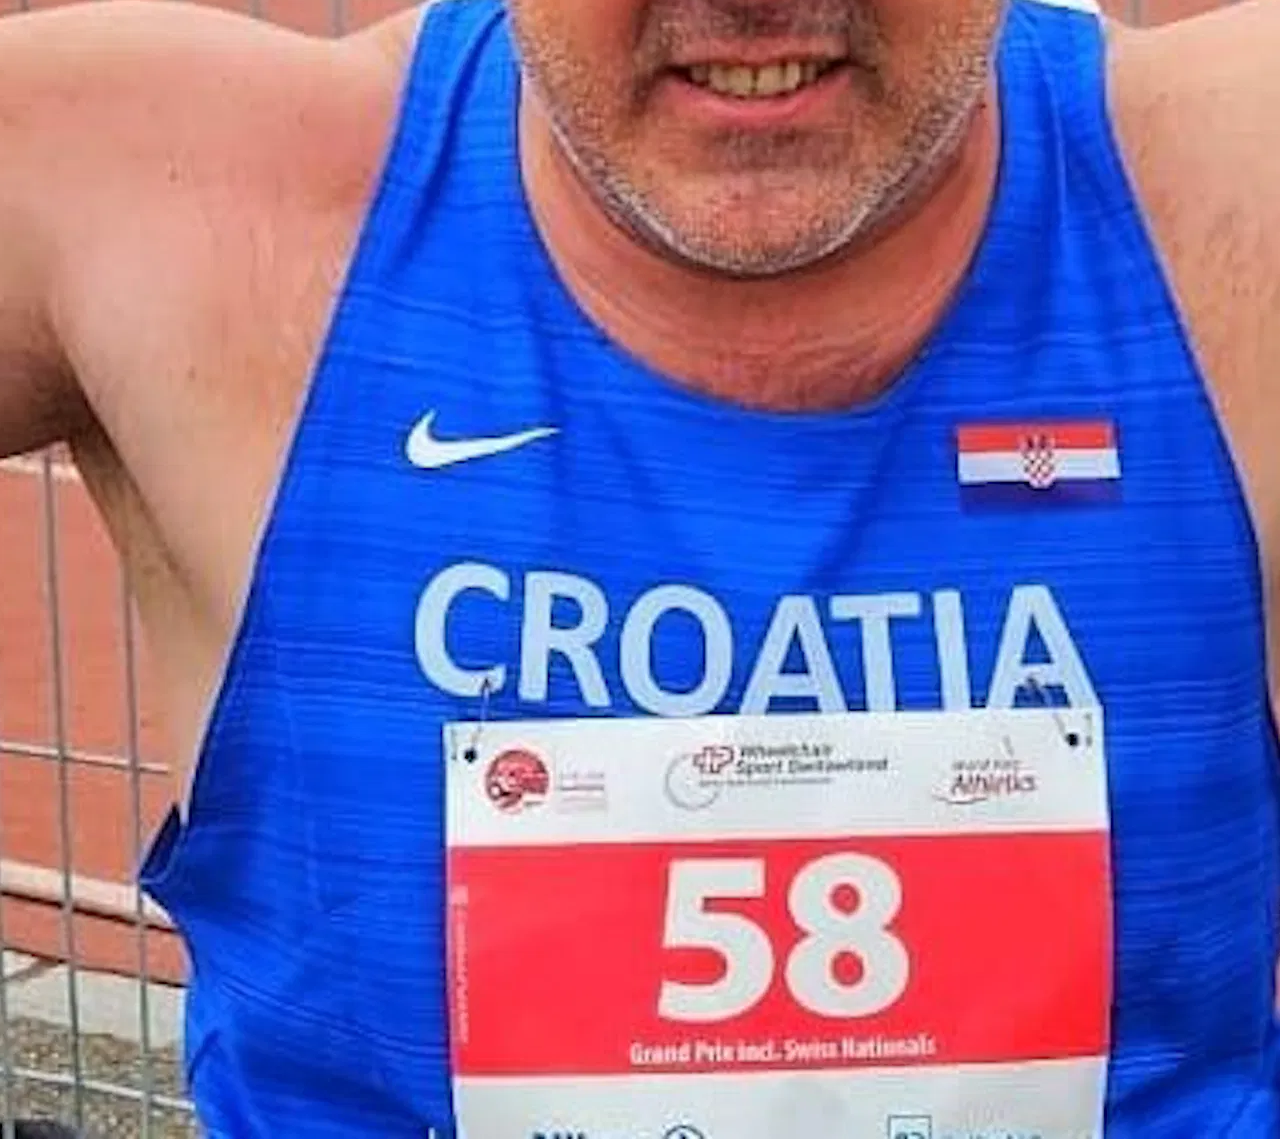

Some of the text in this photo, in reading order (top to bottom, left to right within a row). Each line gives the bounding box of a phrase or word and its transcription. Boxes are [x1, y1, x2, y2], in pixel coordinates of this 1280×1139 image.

[415, 561, 1101, 718] CROATIA
[657, 852, 910, 1022] 58
[629, 1039, 691, 1065] Grand
[694, 1040, 734, 1063] Prix
[783, 1037, 838, 1063] Swiss
[840, 1031, 937, 1059] Nationals
